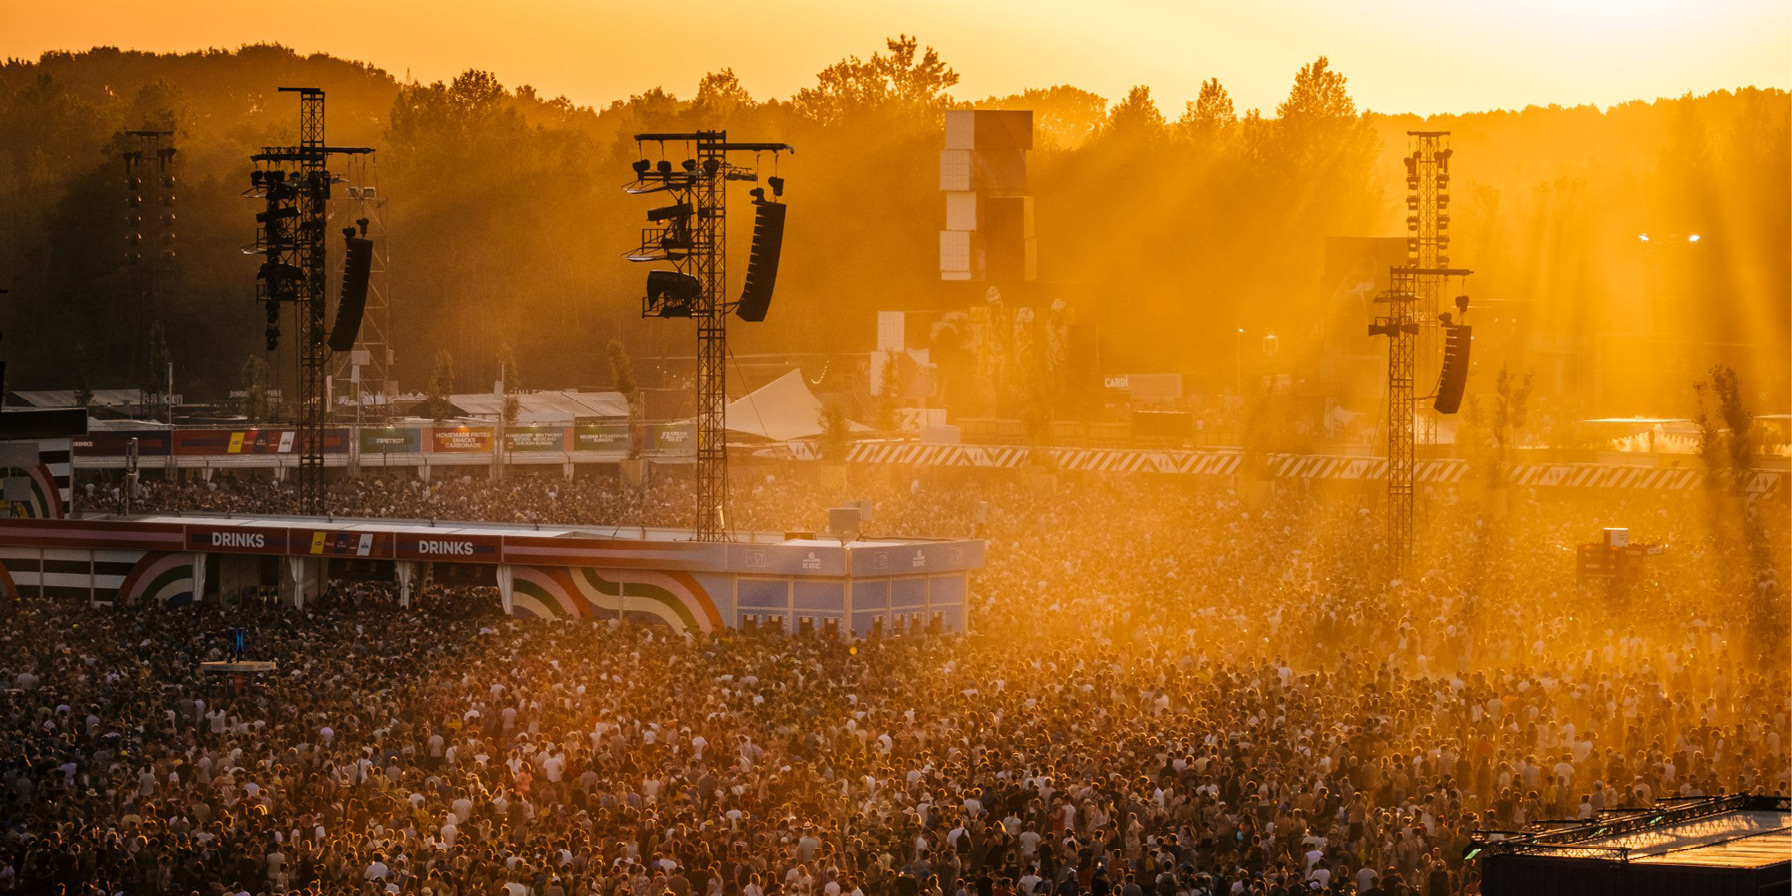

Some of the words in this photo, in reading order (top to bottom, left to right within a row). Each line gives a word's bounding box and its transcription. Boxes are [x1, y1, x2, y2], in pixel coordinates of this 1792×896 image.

[211, 532, 265, 548] DRINKS
[418, 540, 474, 556] DRINKS
[802, 562, 822, 570] KBC
